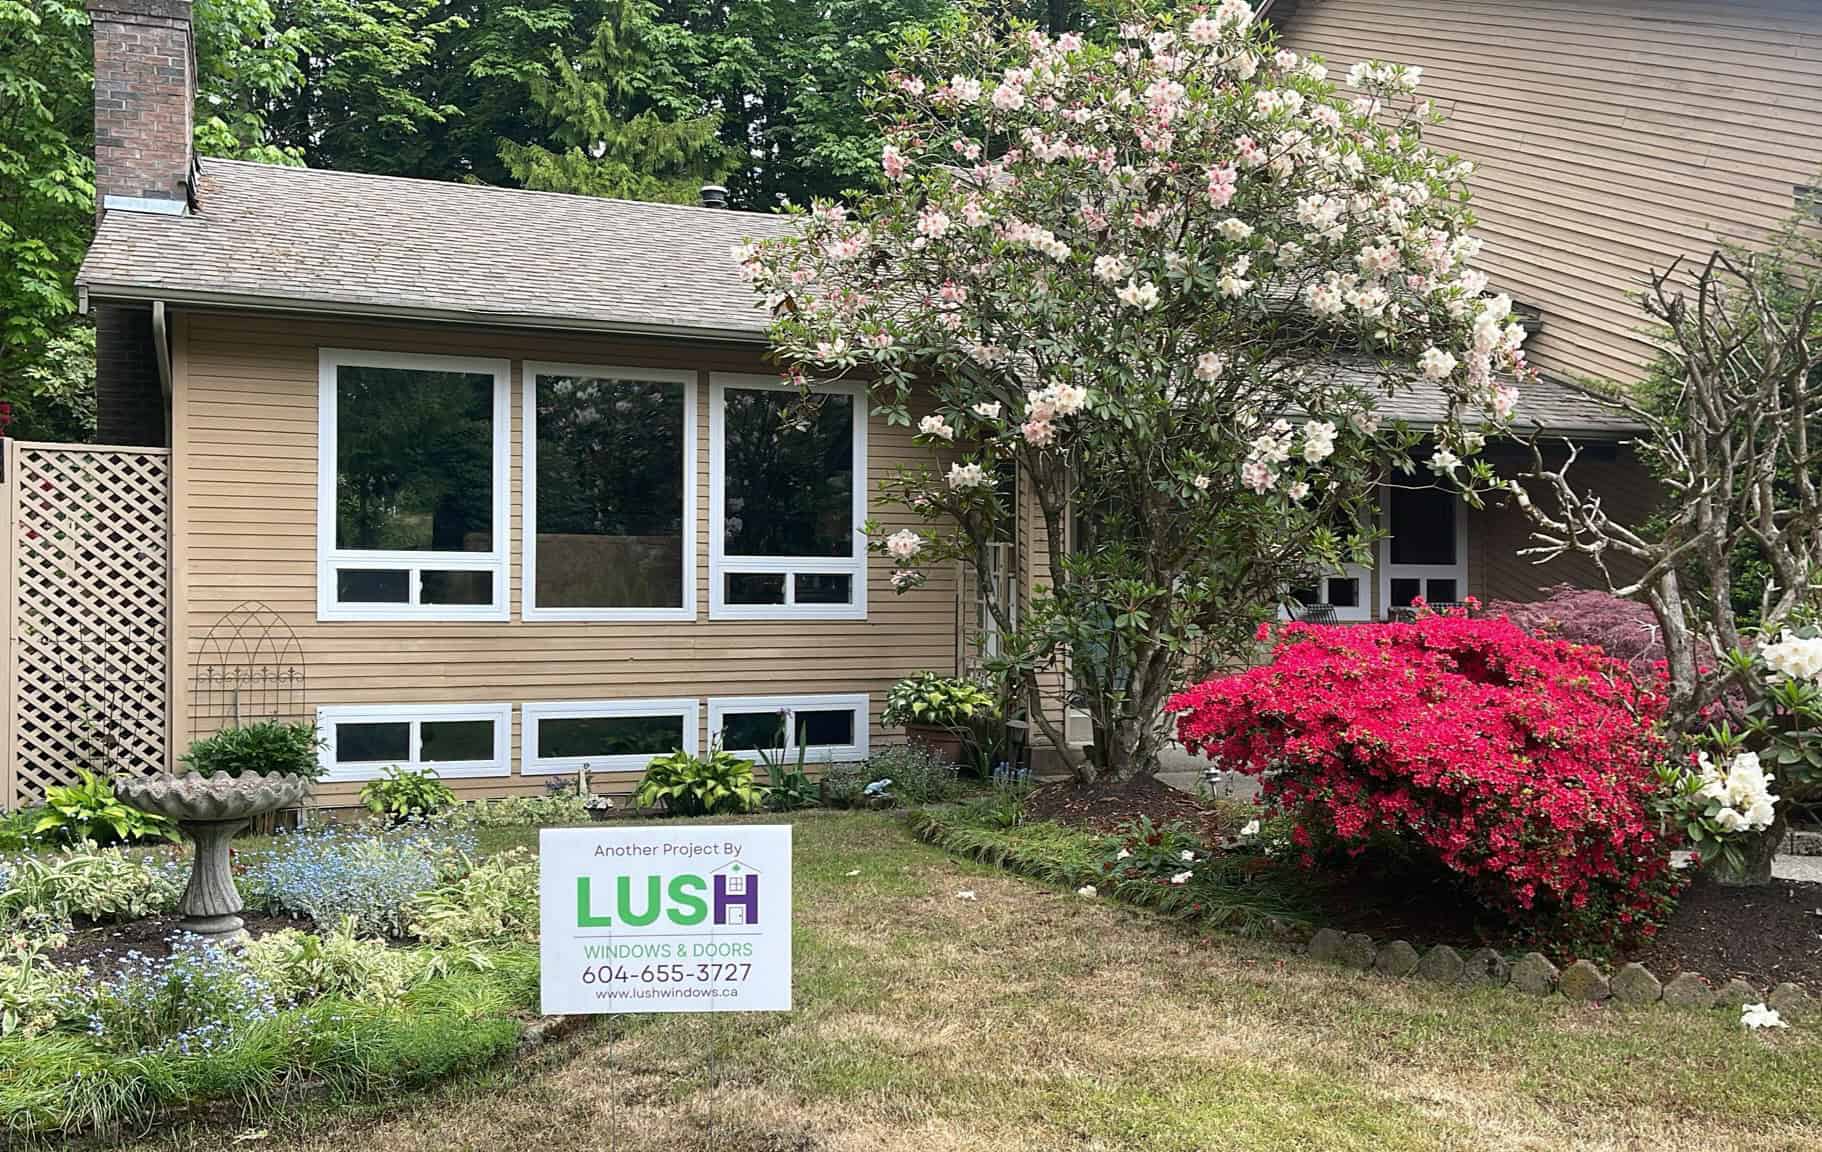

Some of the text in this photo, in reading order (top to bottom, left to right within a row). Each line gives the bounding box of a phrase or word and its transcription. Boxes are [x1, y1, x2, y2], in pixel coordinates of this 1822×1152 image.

[594, 843, 742, 858] Another Project By
[576, 874, 759, 928] LUSH
[584, 943, 752, 960] WINDOWS & DOORS
[582, 964, 752, 984] 604-655-3727
[595, 987, 738, 1000] www.lushwindows.ca
